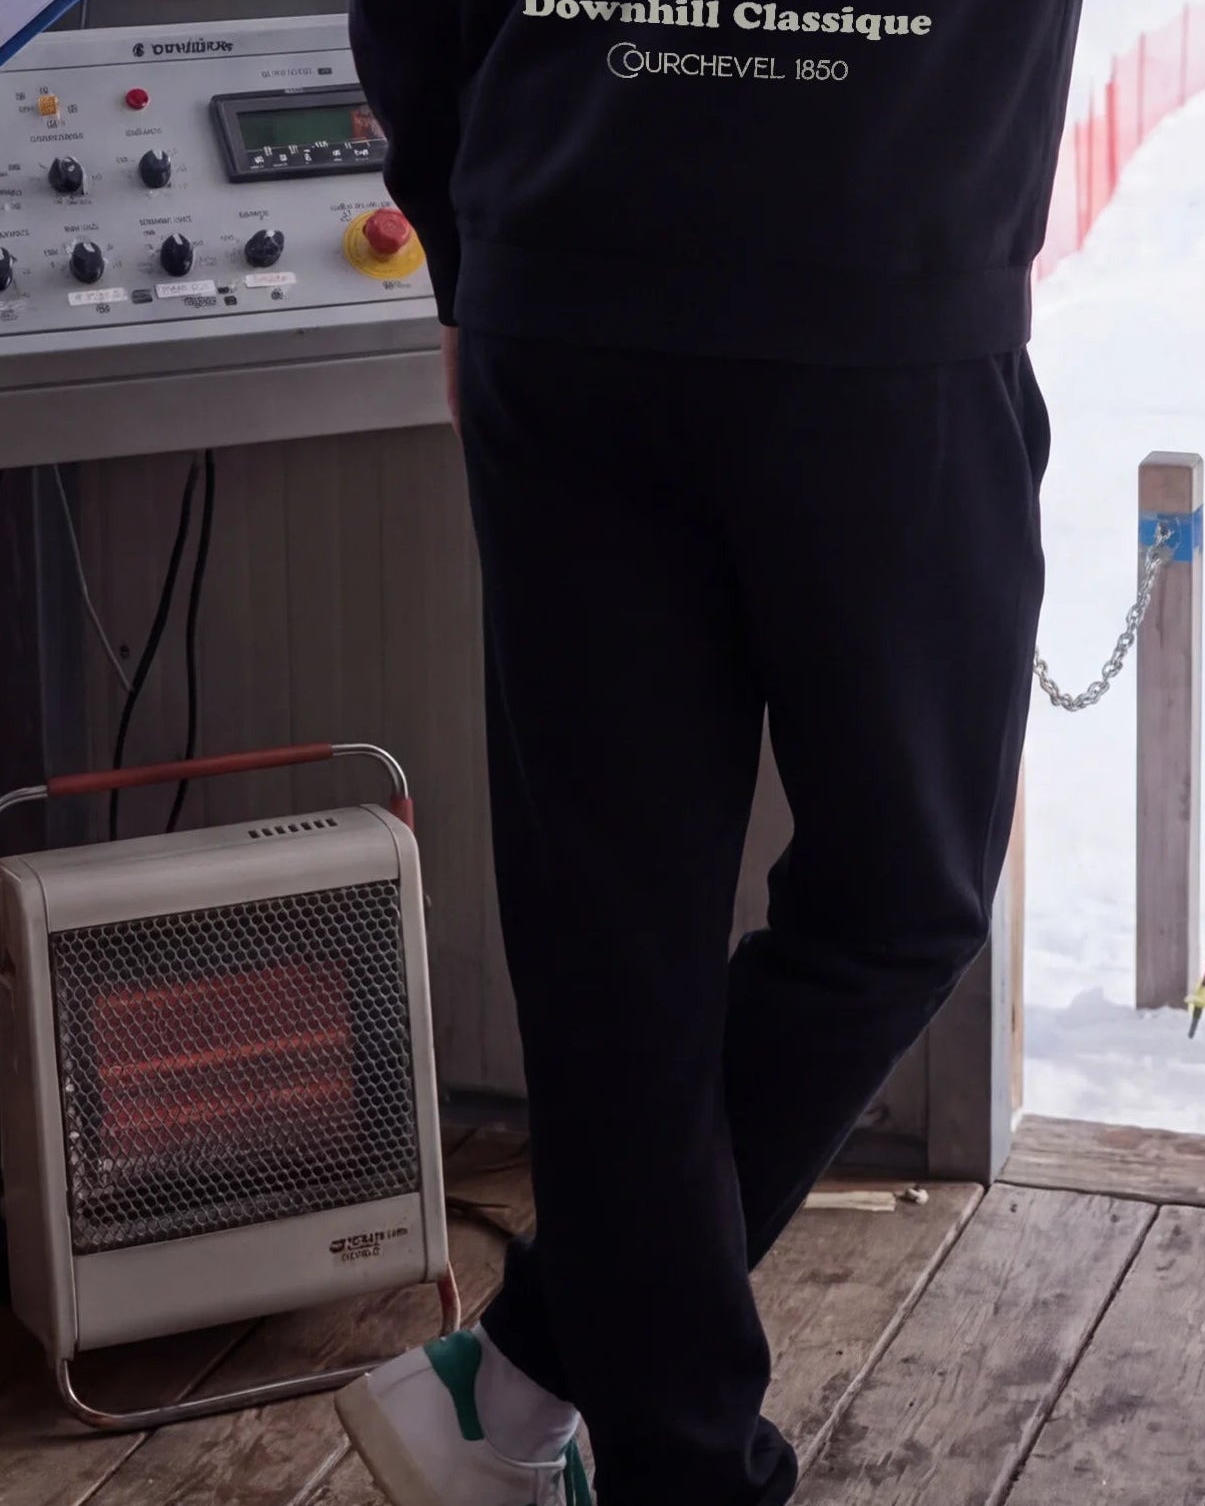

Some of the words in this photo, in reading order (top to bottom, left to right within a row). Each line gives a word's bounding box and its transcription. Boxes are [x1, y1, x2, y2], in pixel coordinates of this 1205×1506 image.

[732, 1, 932, 41] Classique
[606, 41, 786, 80] COURCHEVEL
[795, 58, 849, 81] 1850
